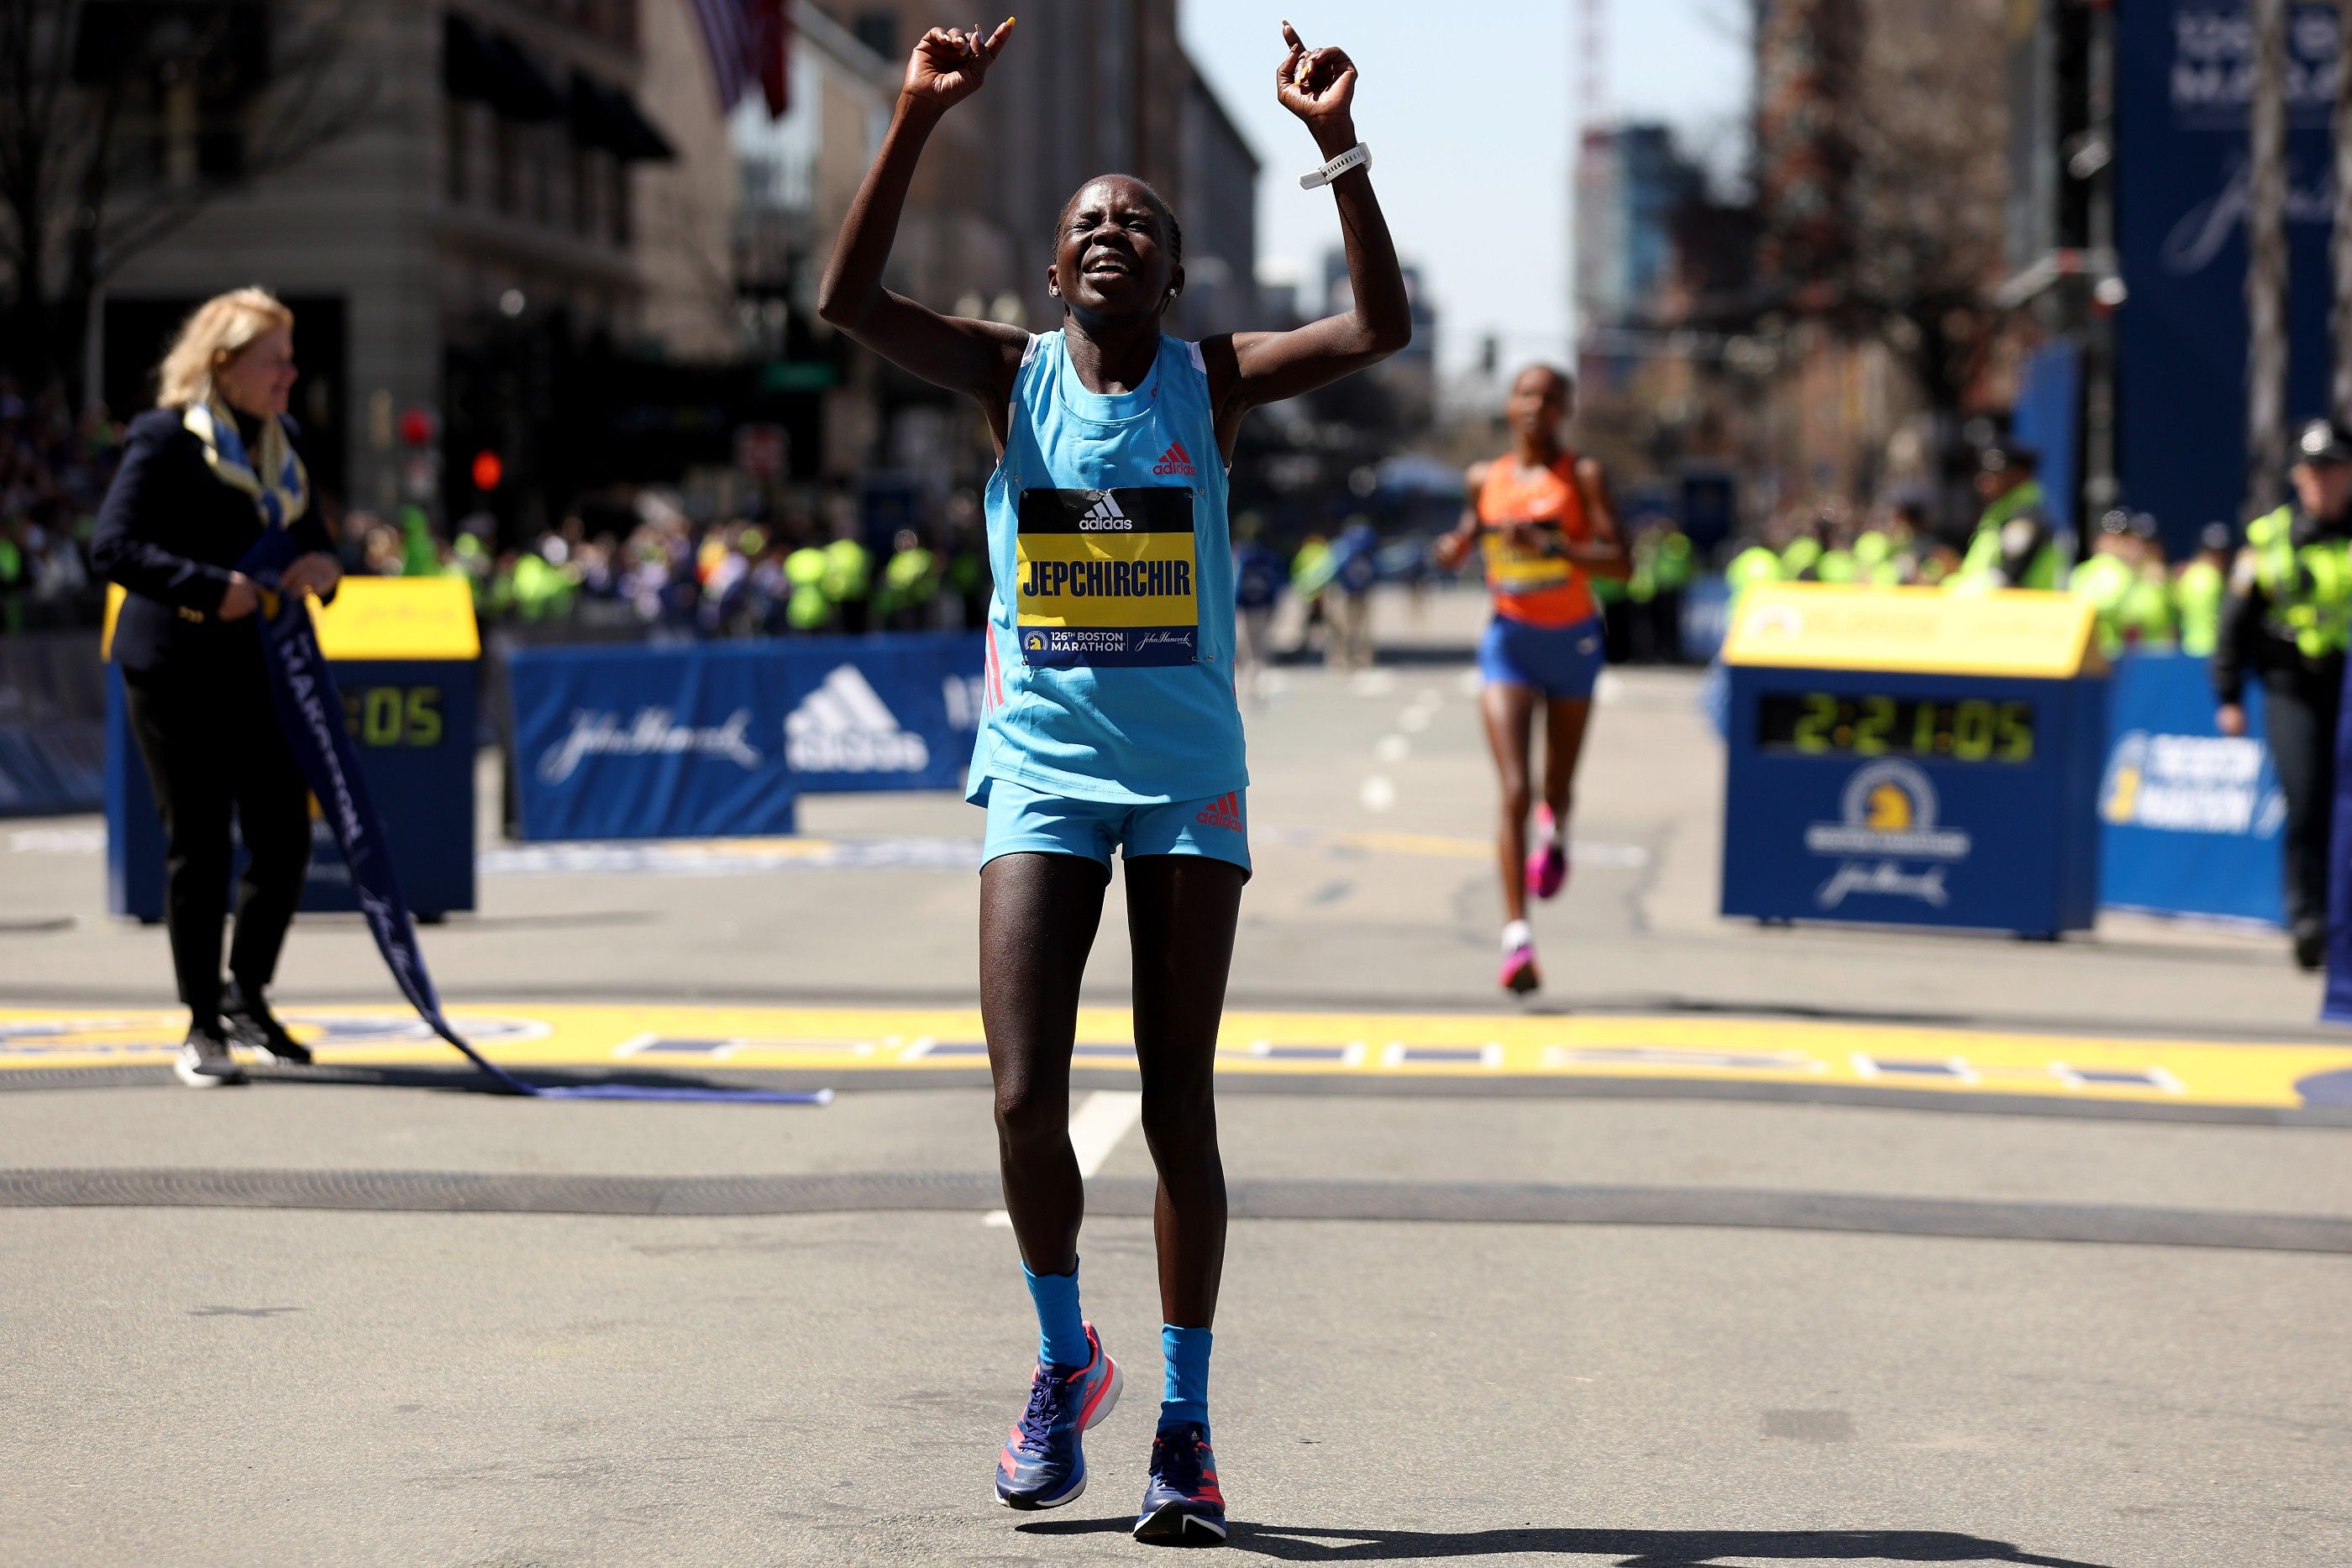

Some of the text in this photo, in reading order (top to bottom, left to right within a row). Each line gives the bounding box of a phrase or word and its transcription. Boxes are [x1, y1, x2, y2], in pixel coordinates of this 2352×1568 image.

[1152, 463, 1196, 476] adidas
[1079, 517, 1132, 530] adidas
[1023, 560, 1191, 597] JEPCHIRCHIR
[1051, 632, 1076, 641] 126TH
[1077, 632, 1123, 642] BOSTON
[1051, 642, 1124, 652] MARATHON
